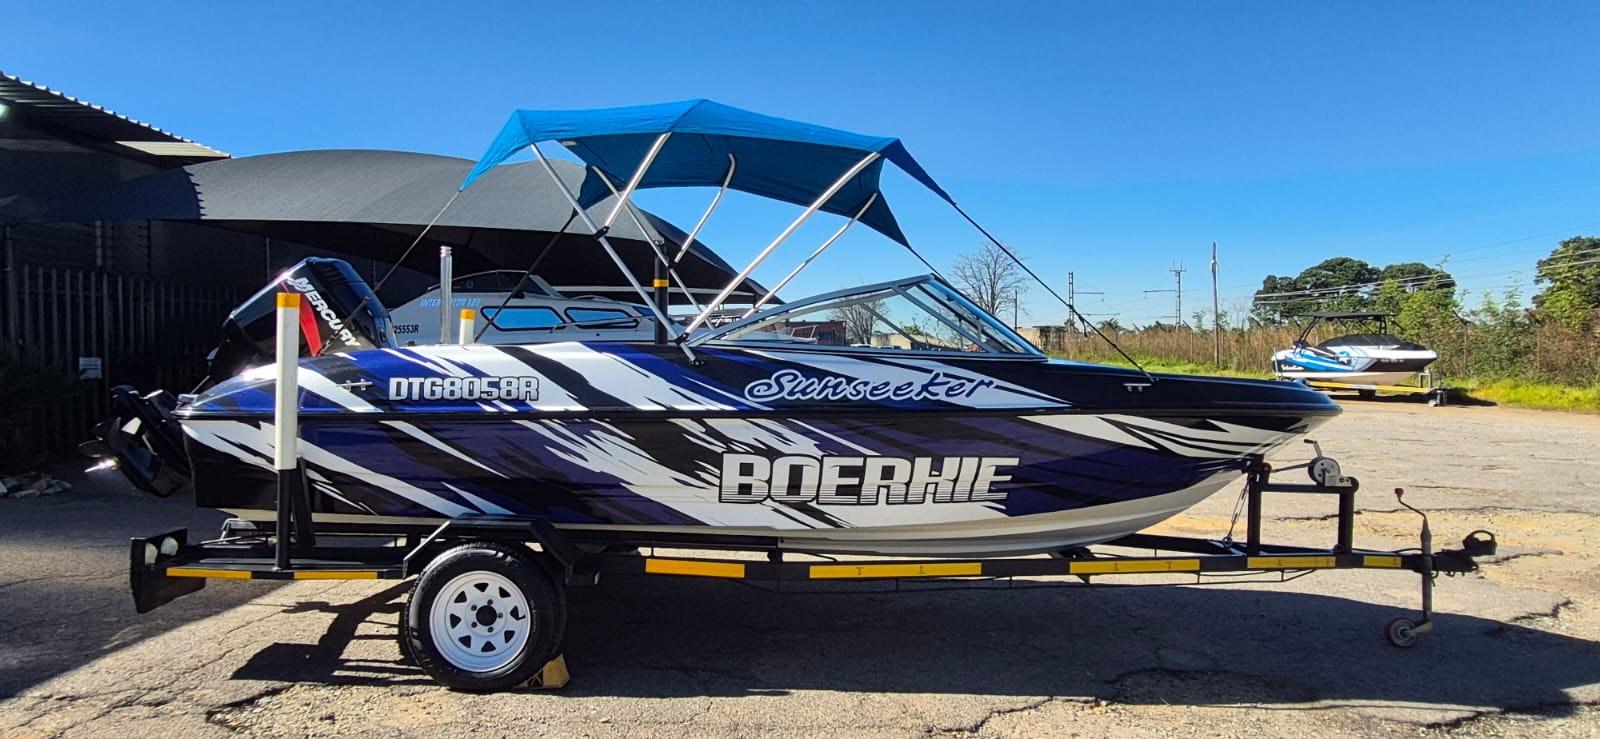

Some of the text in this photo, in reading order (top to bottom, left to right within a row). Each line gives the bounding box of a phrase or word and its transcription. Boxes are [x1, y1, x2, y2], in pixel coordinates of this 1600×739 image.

[287, 276, 361, 346] MERCURY
[388, 375, 540, 401] DTG8058R
[745, 369, 995, 400] Sunseeker
[719, 451, 1020, 505] BOERKIE
